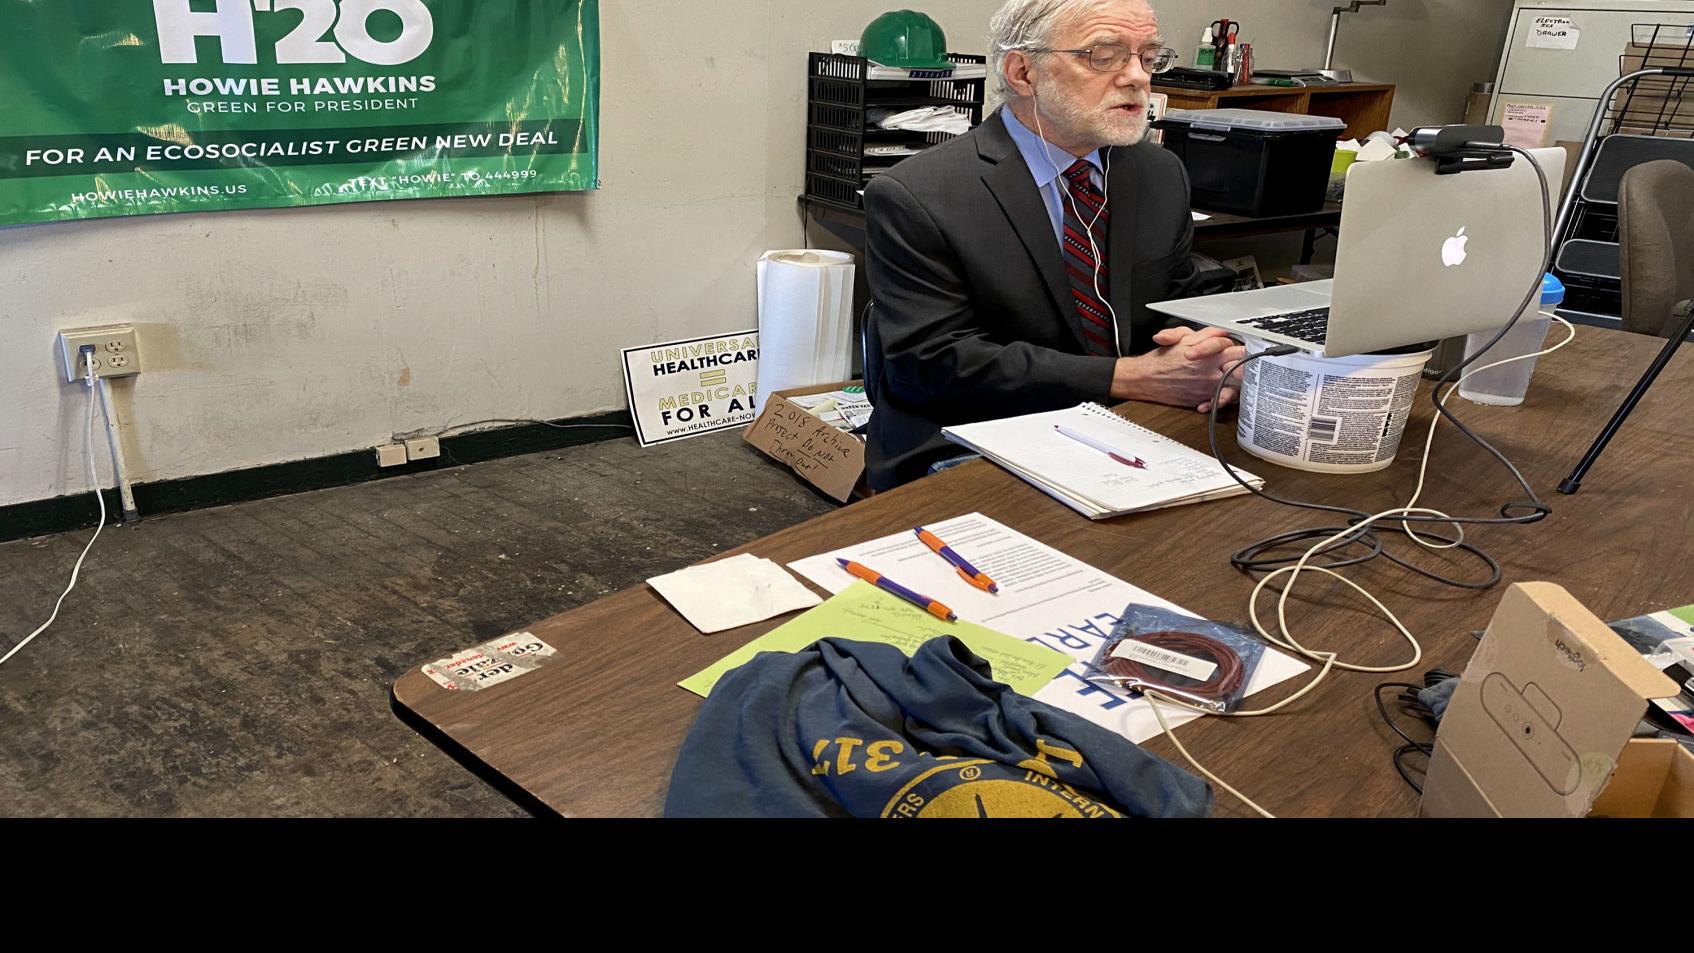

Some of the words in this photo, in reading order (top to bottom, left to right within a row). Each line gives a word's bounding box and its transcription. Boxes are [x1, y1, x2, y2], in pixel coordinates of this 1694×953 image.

[163, 78, 280, 96] HOWIE
[290, 75, 436, 95] HAWKINS
[187, 101, 257, 113] GREEN
[266, 101, 305, 113] FOR
[315, 98, 418, 112] PRESIDENT
[25, 148, 84, 166] FOR
[93, 146, 136, 163] AN
[146, 140, 339, 161] ECOSOCIALIST
[346, 136, 427, 153] GREEN
[435, 132, 492, 149] NEW
[499, 131, 559, 147] DEAL
[348, 176, 387, 189] TEXT
[460, 172, 480, 181] TO
[485, 169, 537, 180] 444999
[71, 184, 247, 203] HOWIEHAWKINS.US
[659, 382, 758, 411] MEDICAR
[662, 404, 711, 426] FOR
[728, 395, 756, 413] AL
[667, 412, 756, 435] www.HEALTHCARE-NO
[774, 403, 810, 428] 2018
[812, 425, 850, 458] Archive
